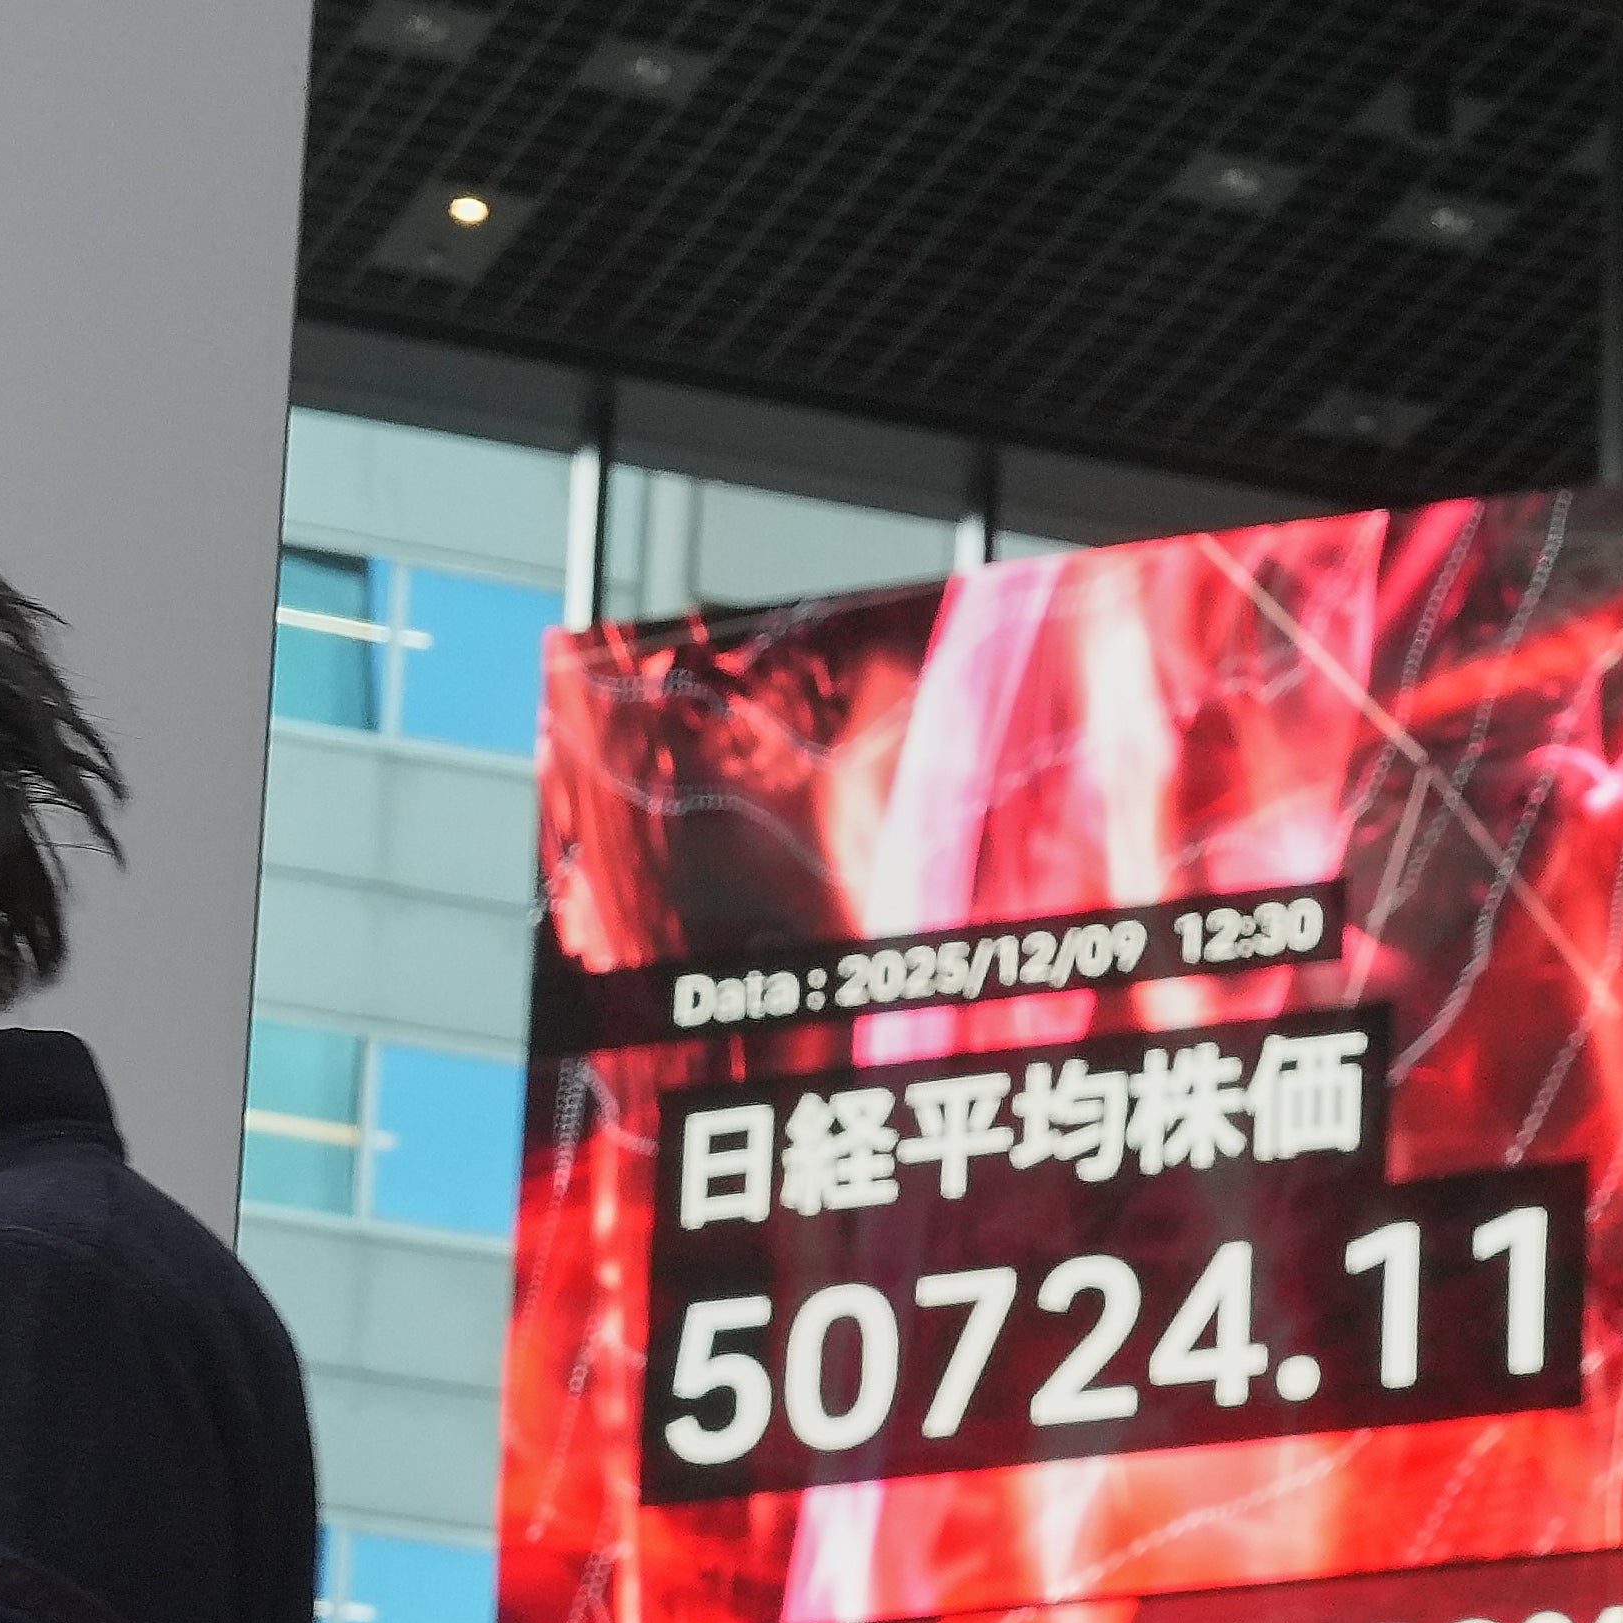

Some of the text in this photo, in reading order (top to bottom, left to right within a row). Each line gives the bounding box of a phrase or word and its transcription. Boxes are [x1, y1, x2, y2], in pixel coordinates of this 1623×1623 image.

[673, 970, 799, 1027] Data
[834, 920, 1148, 1007] 2025/12/09
[1174, 898, 1325, 965] 12:30
[679, 1031, 1369, 1230] 日経平均株価
[664, 1205, 1549, 1467] 50724.11
